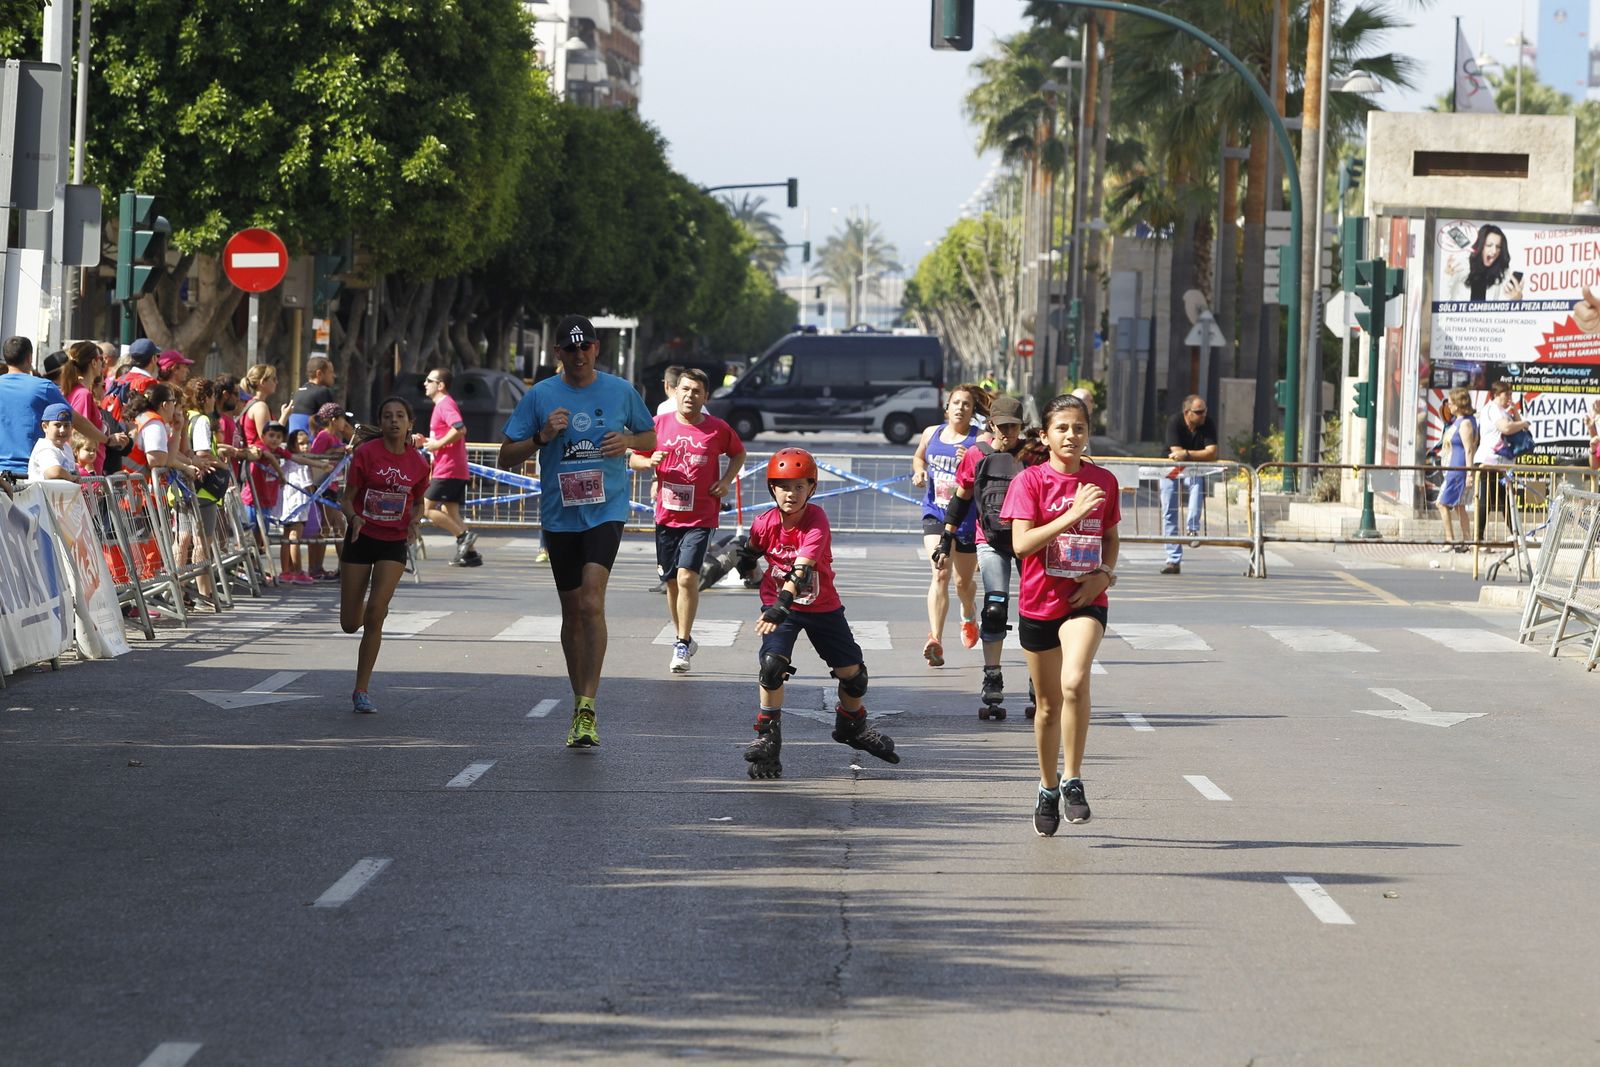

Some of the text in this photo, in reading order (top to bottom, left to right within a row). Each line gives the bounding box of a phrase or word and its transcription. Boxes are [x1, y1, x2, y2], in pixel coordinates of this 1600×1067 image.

[1524, 244, 1564, 267] TODO
[1438, 300, 1569, 312] SÓLO TE CAMBIAMOS LA PIEZA DAÑADA
[1554, 350, 1567, 359] AÑO
[1568, 349, 1576, 358] DE
[1524, 394, 1588, 416] MÁXIMA
[579, 479, 600, 492] 156
[672, 491, 690, 501] 250
